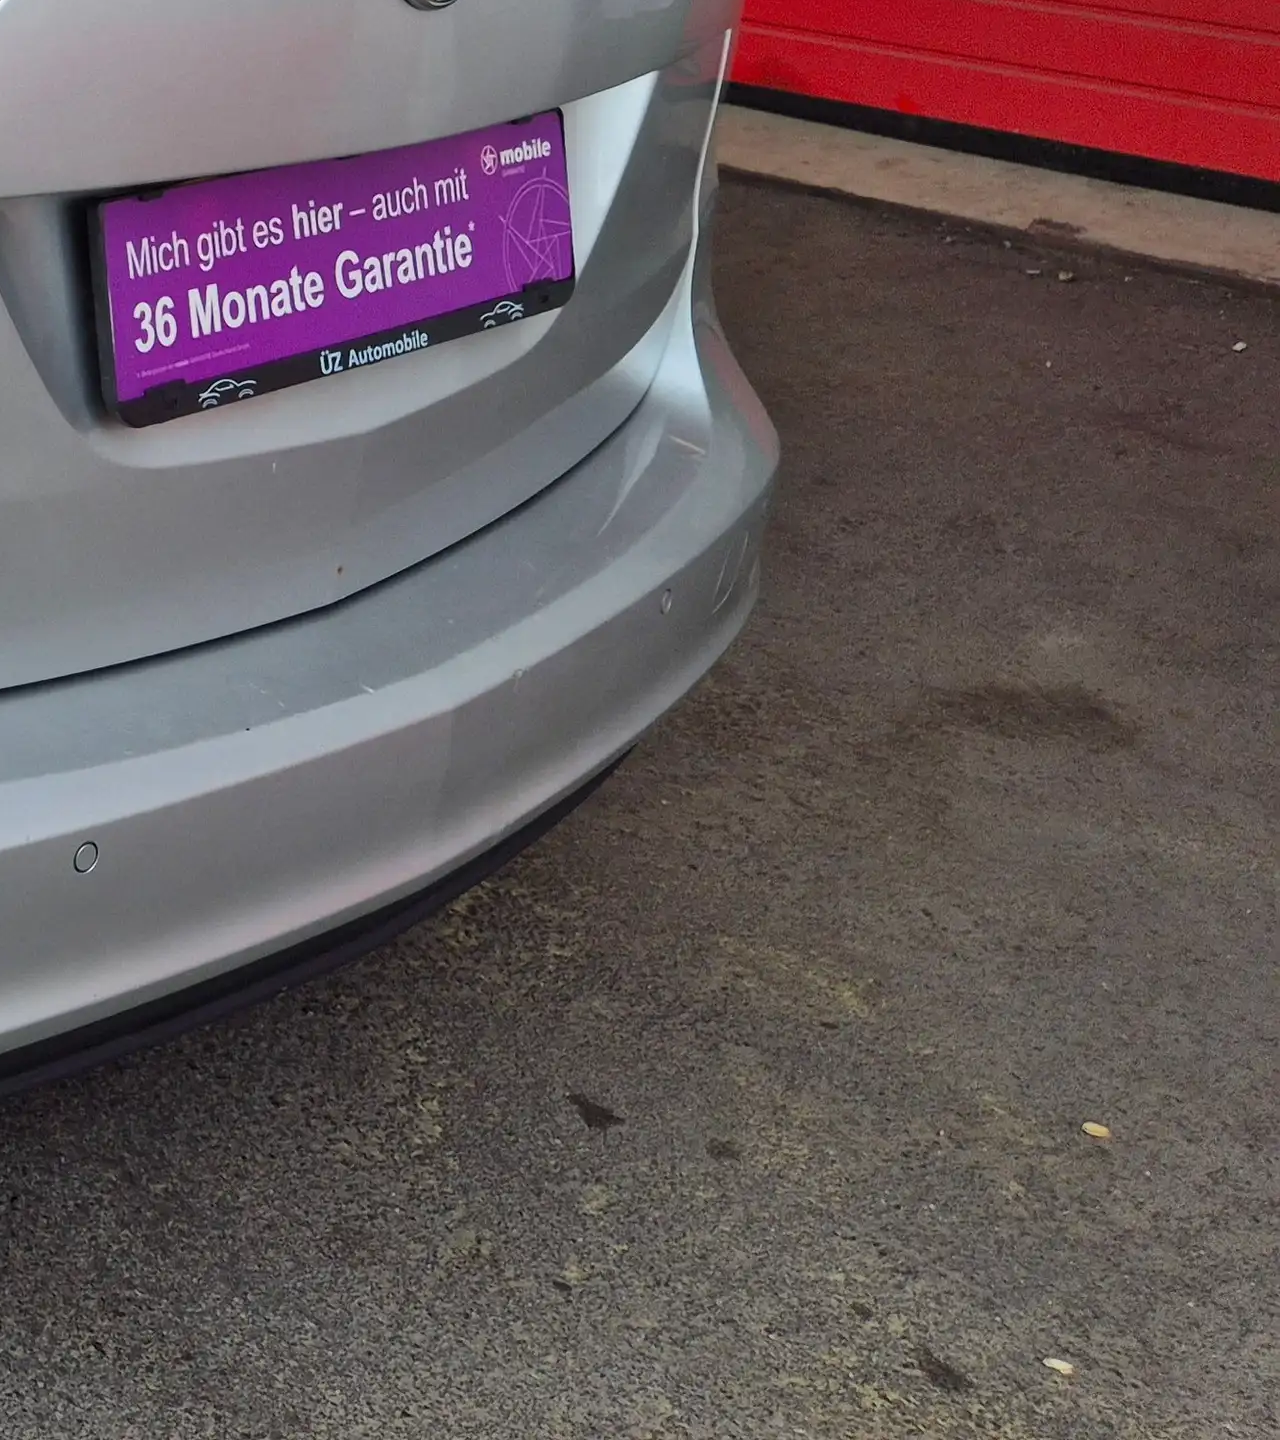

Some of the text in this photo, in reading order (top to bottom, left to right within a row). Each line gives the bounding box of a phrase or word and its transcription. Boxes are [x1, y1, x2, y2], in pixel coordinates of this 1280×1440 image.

[500, 137, 551, 166] mobile
[126, 231, 190, 280] Mich
[197, 217, 247, 272] gibt
[253, 217, 284, 248] es
[291, 200, 343, 240] hier
[372, 177, 428, 221] auch
[434, 168, 469, 207] mit
[133, 296, 178, 353] 36
[188, 265, 325, 339] Monate
[320, 329, 429, 375] ÜZ Automobile
